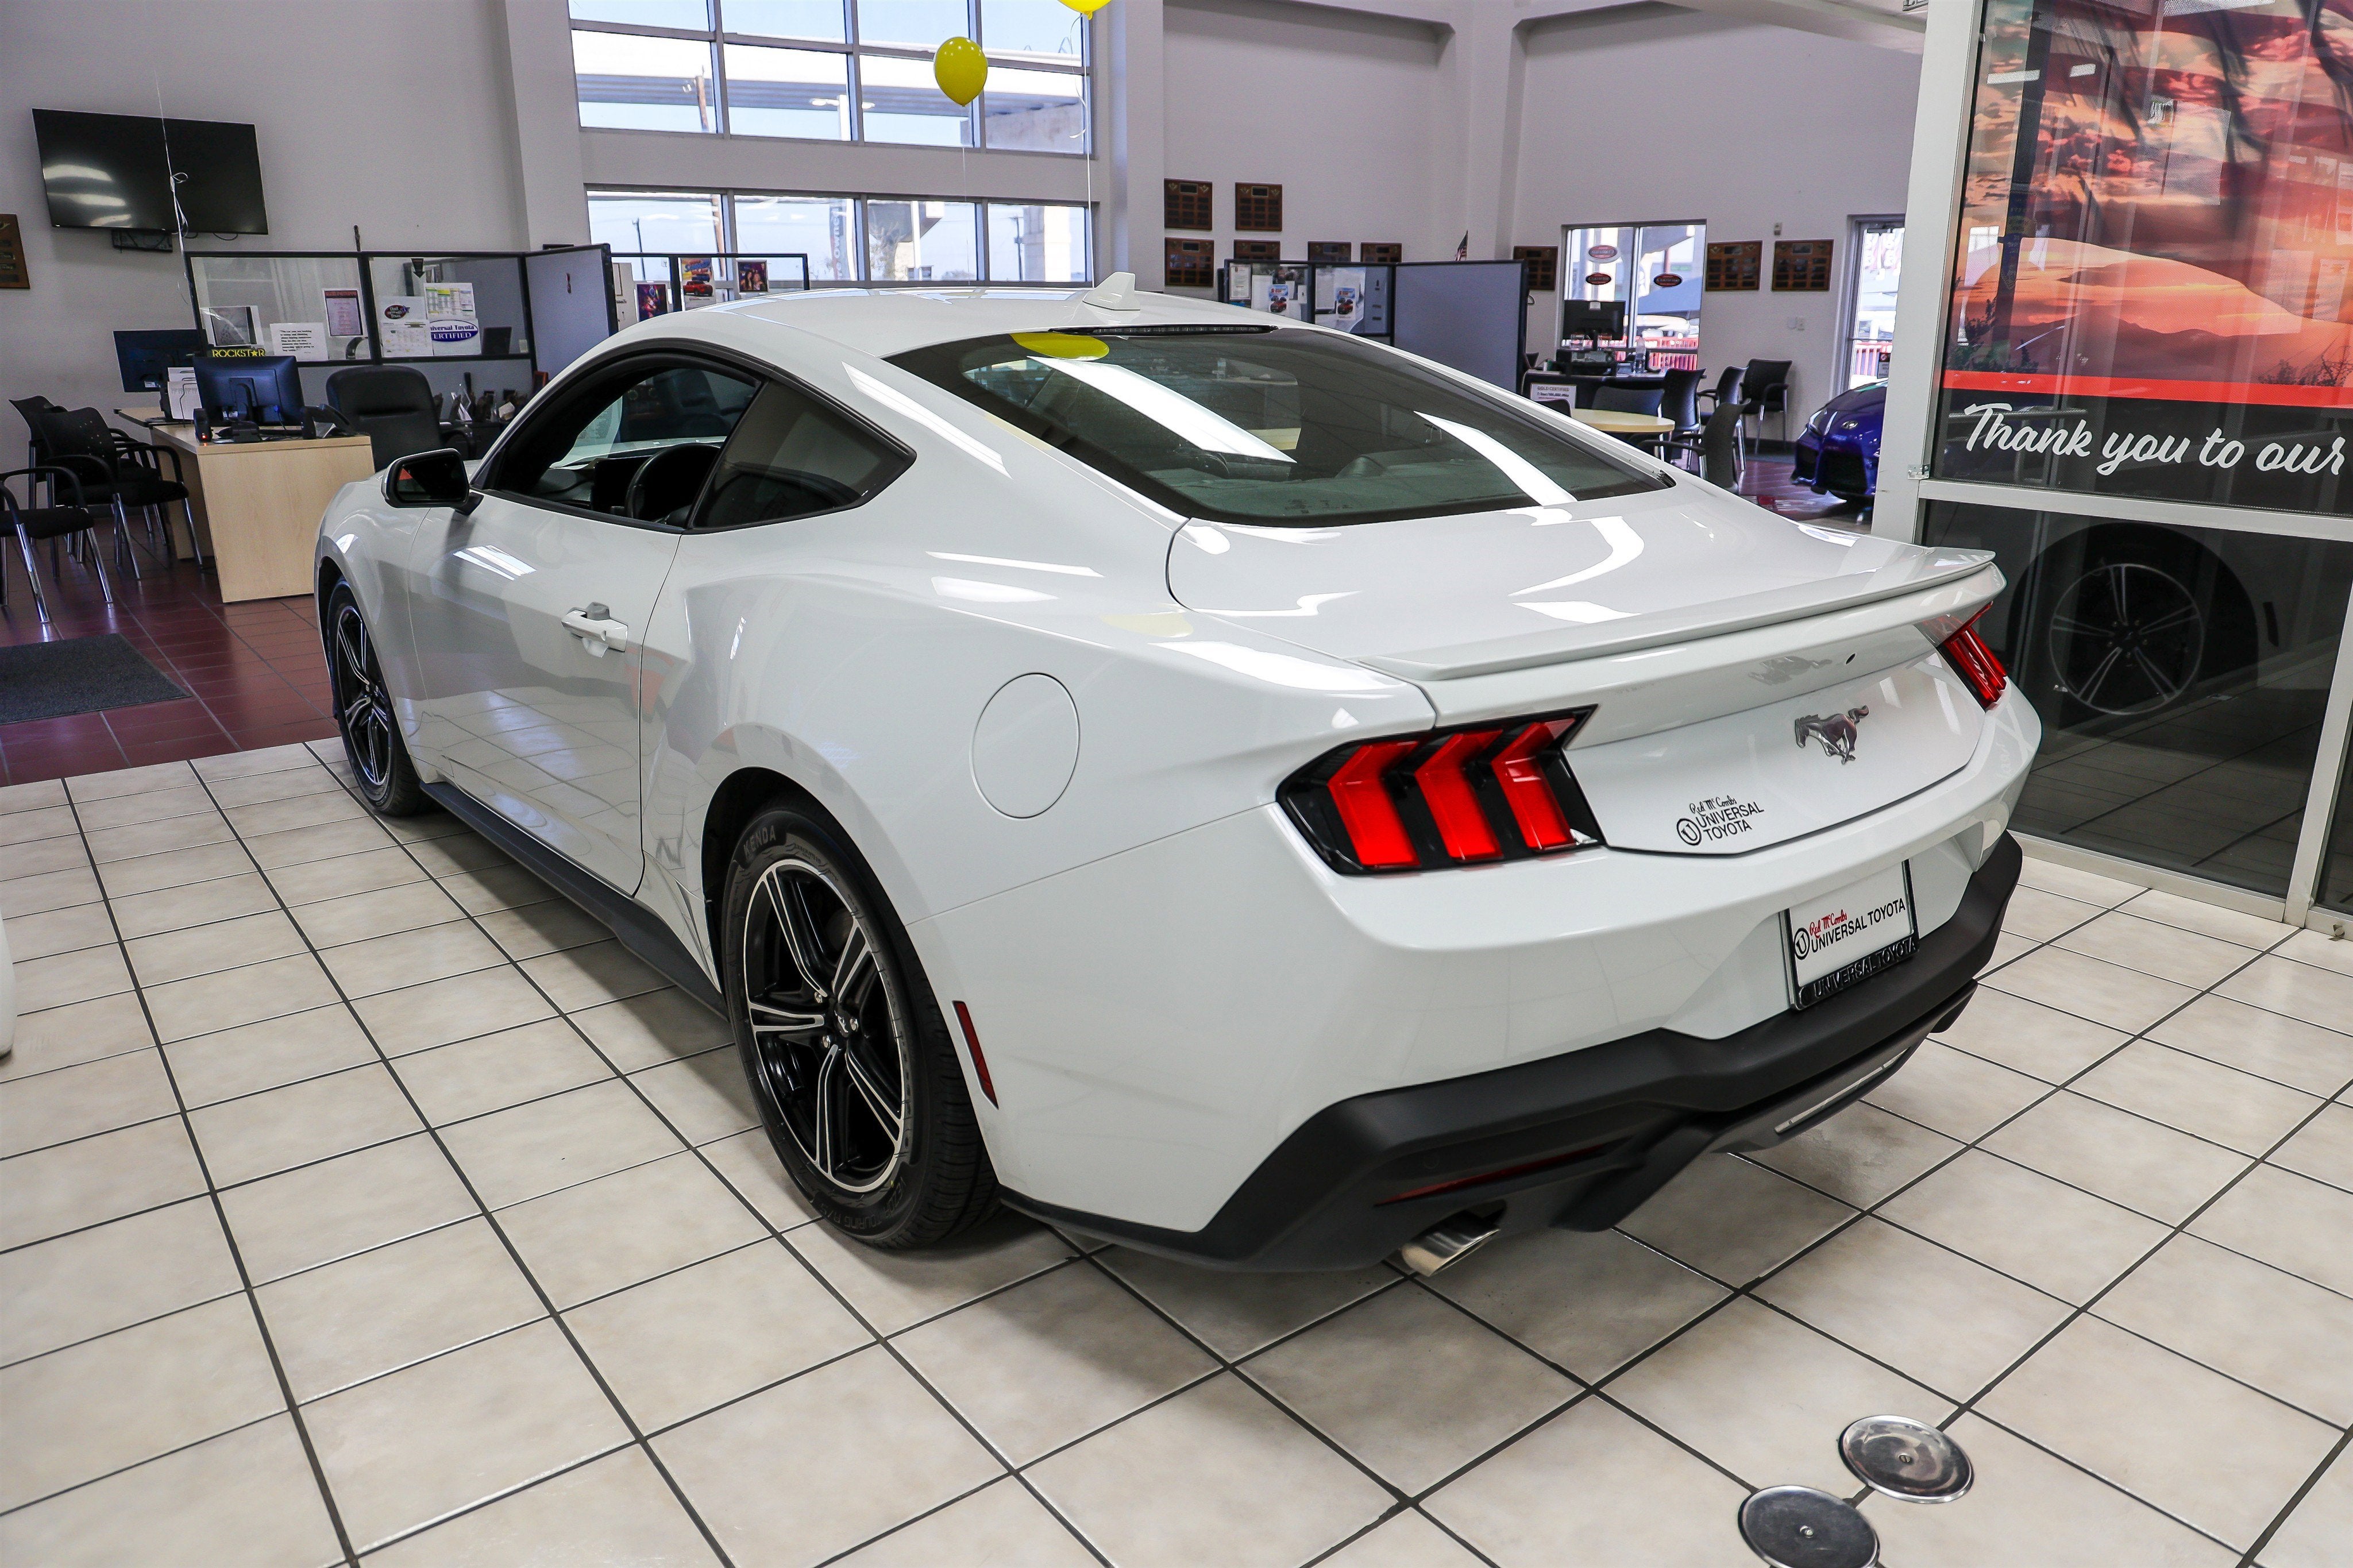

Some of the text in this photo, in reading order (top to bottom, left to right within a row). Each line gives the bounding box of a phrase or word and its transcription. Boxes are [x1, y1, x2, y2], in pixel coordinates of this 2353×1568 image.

[1964, 403, 2347, 476] Thank you to our
[1689, 802, 1706, 816] Red
[1696, 802, 1765, 828] UNIVERSAL
[743, 825, 776, 861] KENDA
[1703, 820, 1753, 841] TOYOTA
[1810, 920, 1822, 939] Red
[1811, 898, 1906, 953] UNIVERSAL TOYOTA
[1814, 937, 1916, 998] UNIVERSAL TOYOTA
[844, 1213, 883, 1230] TOURING
